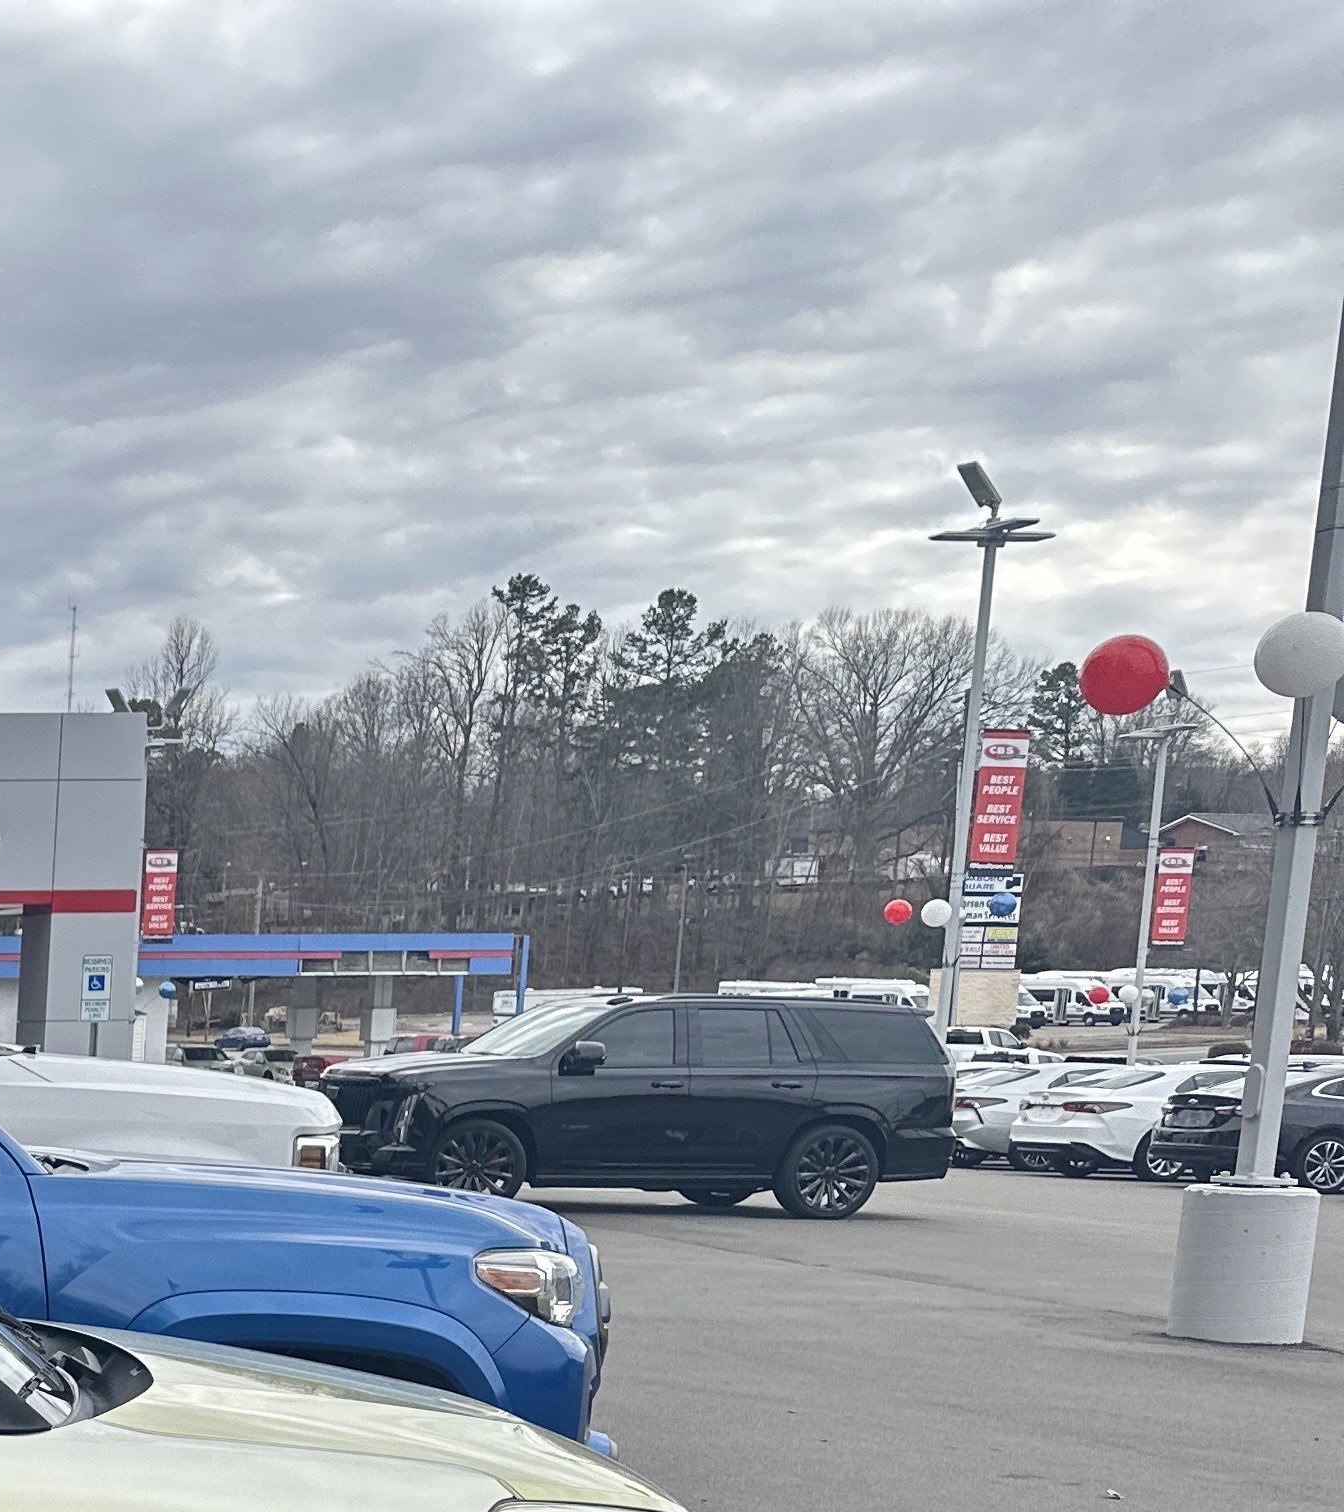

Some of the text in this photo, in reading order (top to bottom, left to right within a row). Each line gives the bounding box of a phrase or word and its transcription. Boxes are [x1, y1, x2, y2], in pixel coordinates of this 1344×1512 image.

[989, 746, 1014, 755] CBS
[990, 775, 1015, 784] BEST
[982, 785, 1019, 795] PEOPLE
[986, 804, 1012, 813] BEST
[976, 814, 1017, 824] SERVICE
[983, 833, 1008, 842] BEST
[979, 844, 1009, 854] VALUE
